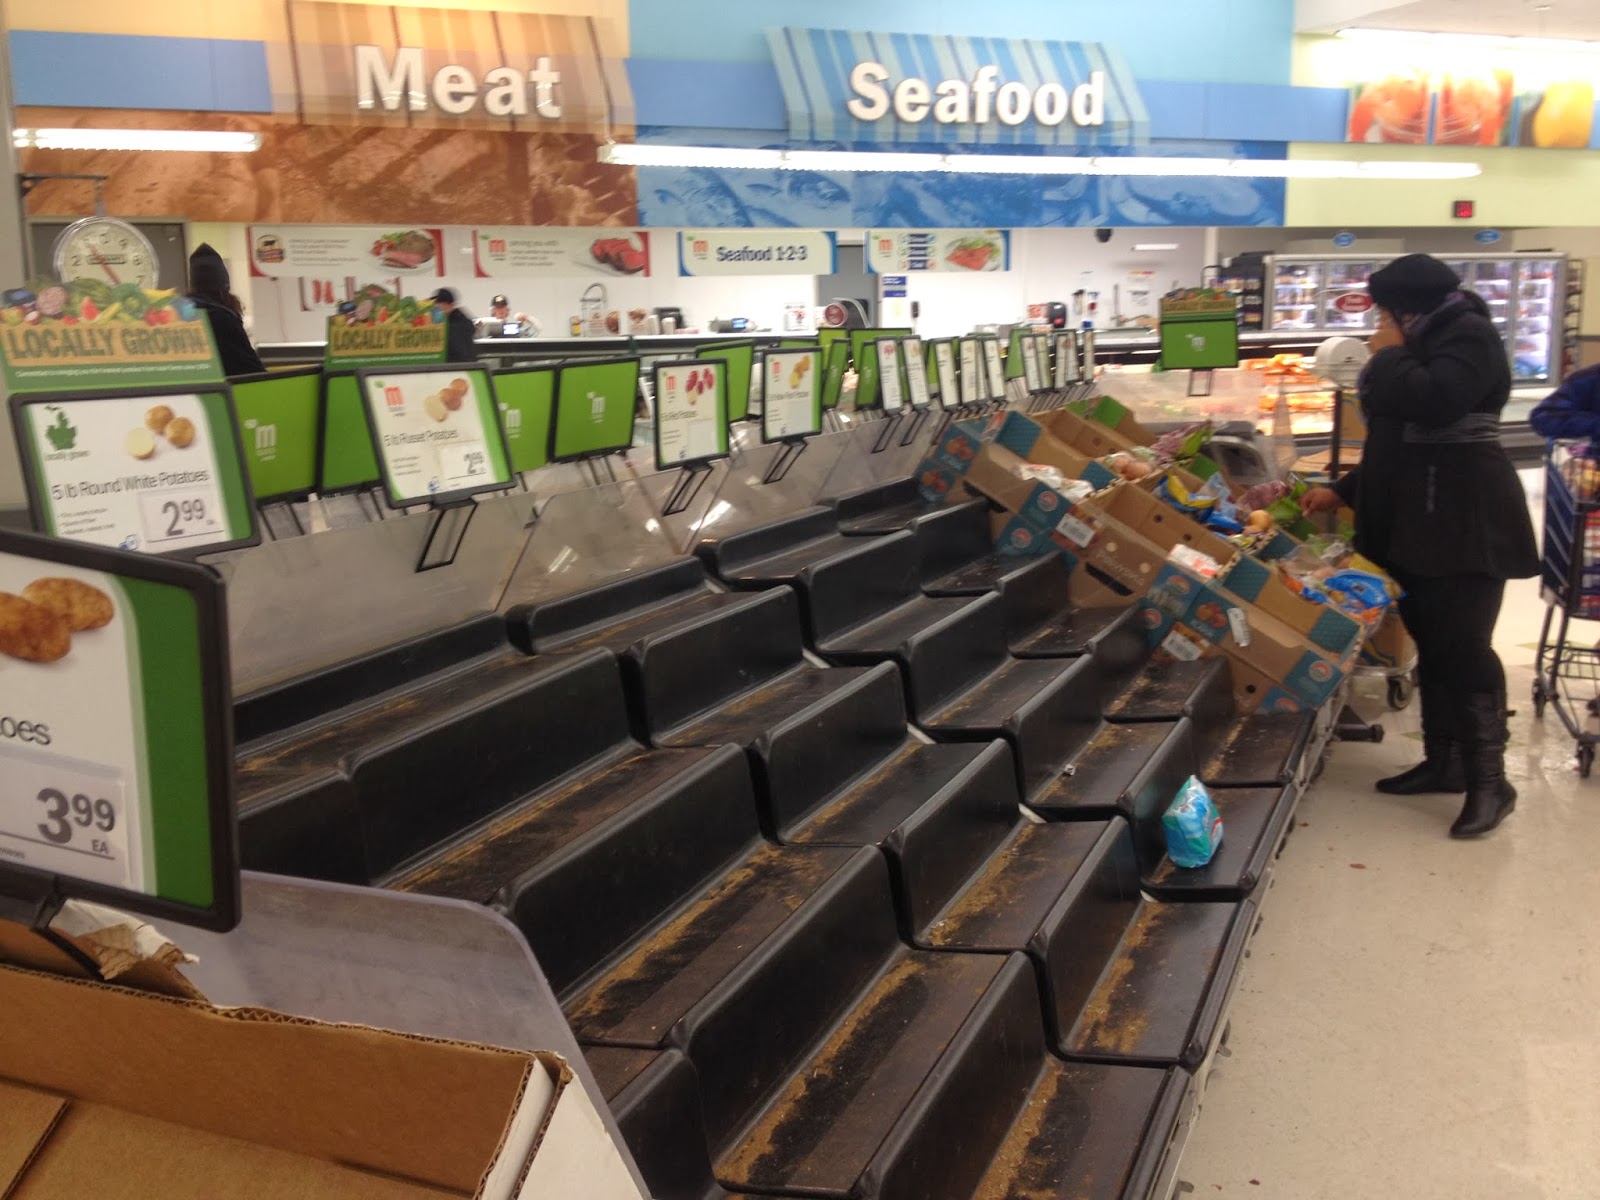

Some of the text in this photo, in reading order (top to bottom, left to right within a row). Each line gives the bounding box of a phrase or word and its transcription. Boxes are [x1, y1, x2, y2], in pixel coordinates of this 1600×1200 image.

[354, 44, 562, 118] Meat
[847, 61, 1105, 126] Seafood
[717, 245, 772, 262] Seafood
[6, 326, 208, 359] LOCALLY GROWN
[52, 469, 210, 501] 5 lb Round White Potatoes
[0, 716, 51, 746] oes
[91, 839, 109, 854] EA
